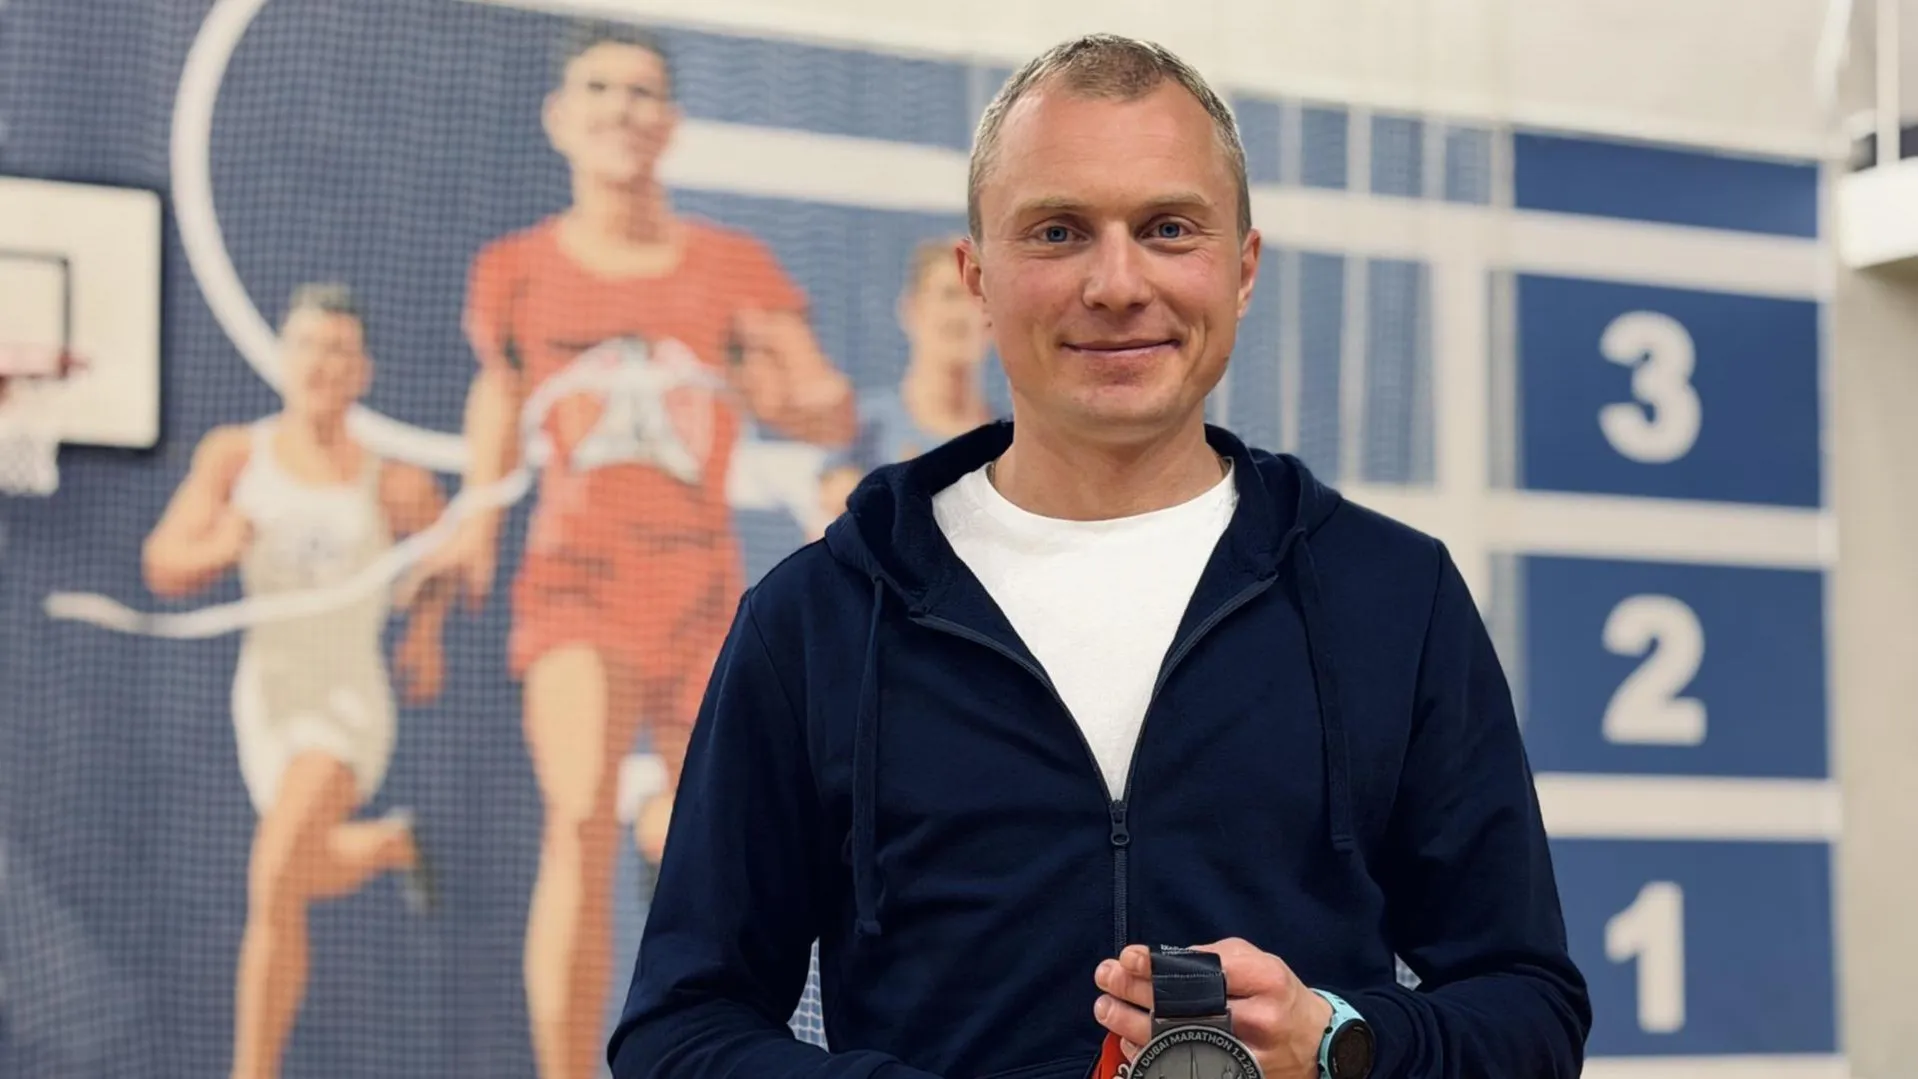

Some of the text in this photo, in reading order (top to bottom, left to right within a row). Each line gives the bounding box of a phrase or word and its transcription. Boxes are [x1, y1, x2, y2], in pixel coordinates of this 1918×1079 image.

[1600, 310, 1702, 463] 3
[1603, 594, 1707, 746] 2
[1606, 881, 1685, 1033] 1
[1133, 1068, 1144, 1079] V
[1140, 1039, 1169, 1067] DUBAI
[1170, 1031, 1233, 1051] MARATHON
